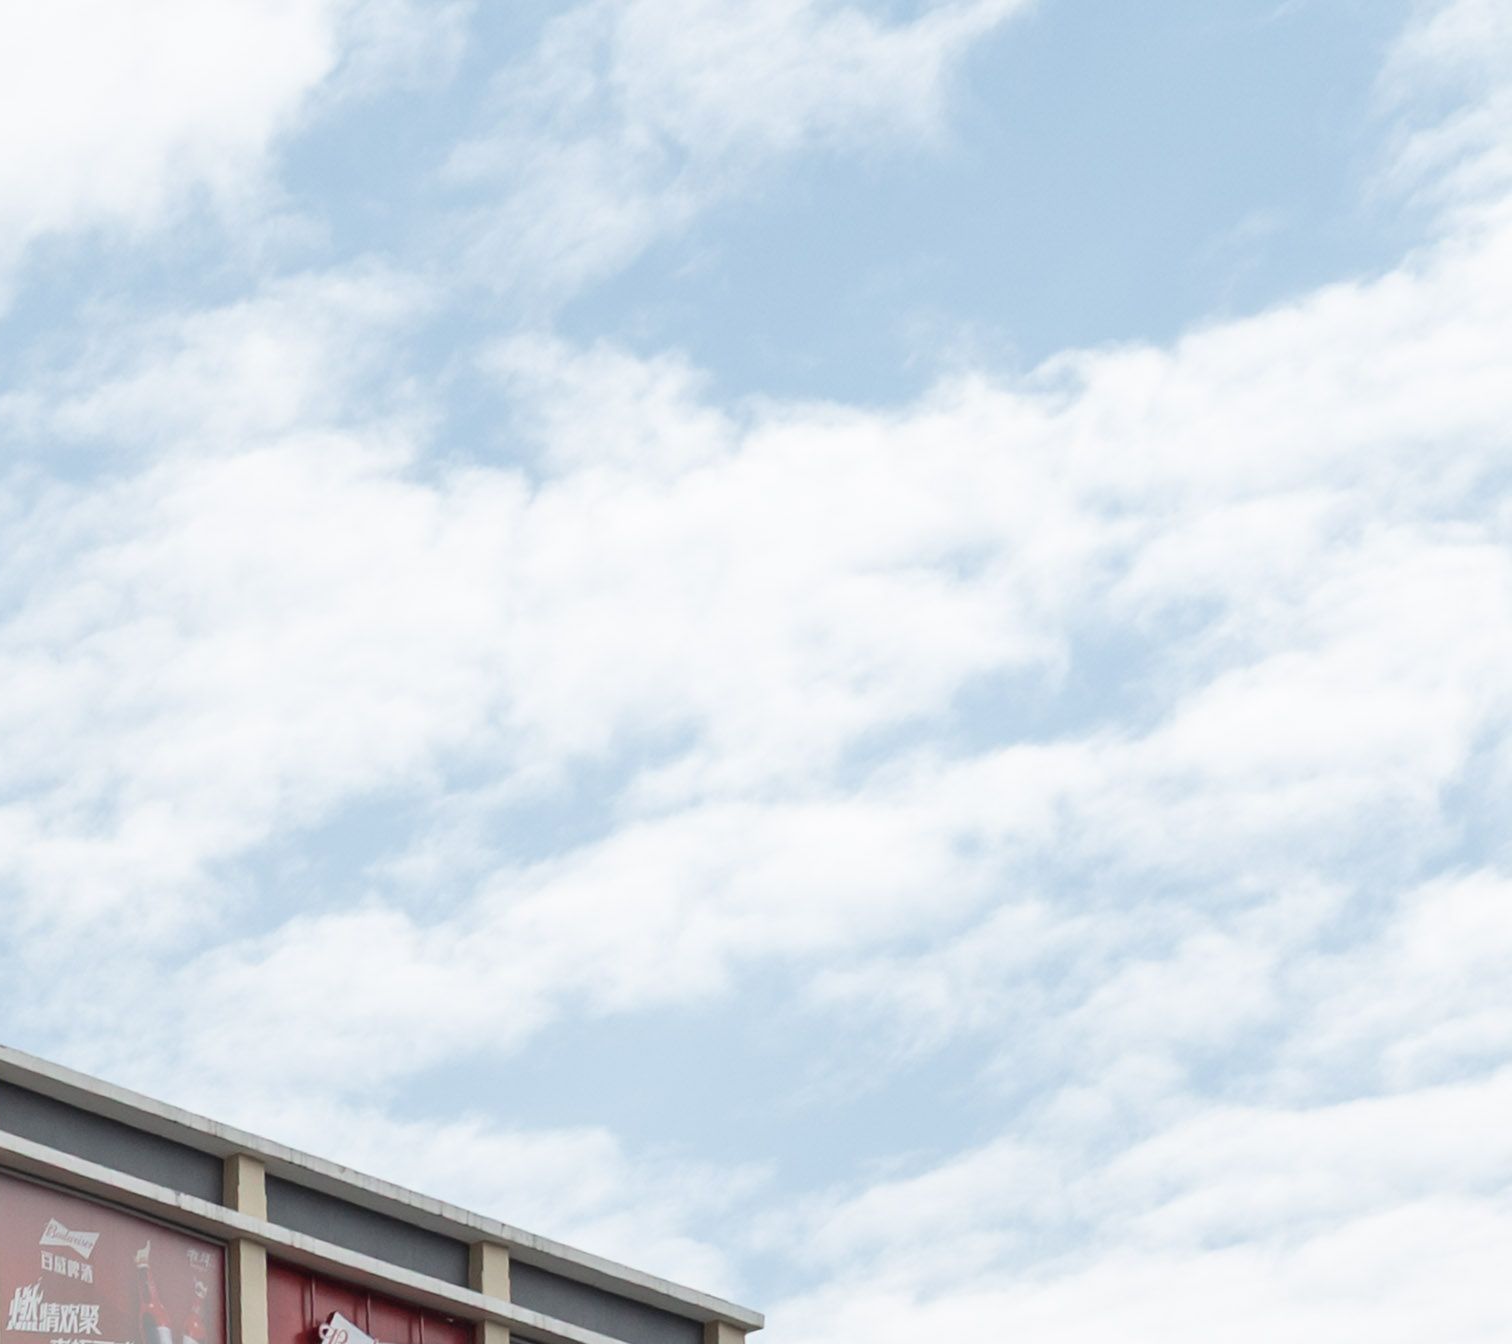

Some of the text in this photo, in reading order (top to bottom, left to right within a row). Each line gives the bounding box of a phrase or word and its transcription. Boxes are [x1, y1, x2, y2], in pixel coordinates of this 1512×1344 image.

[40, 1252, 95, 1285] 百威啤酒
[7, 1280, 102, 1336] 燃情欢聚
